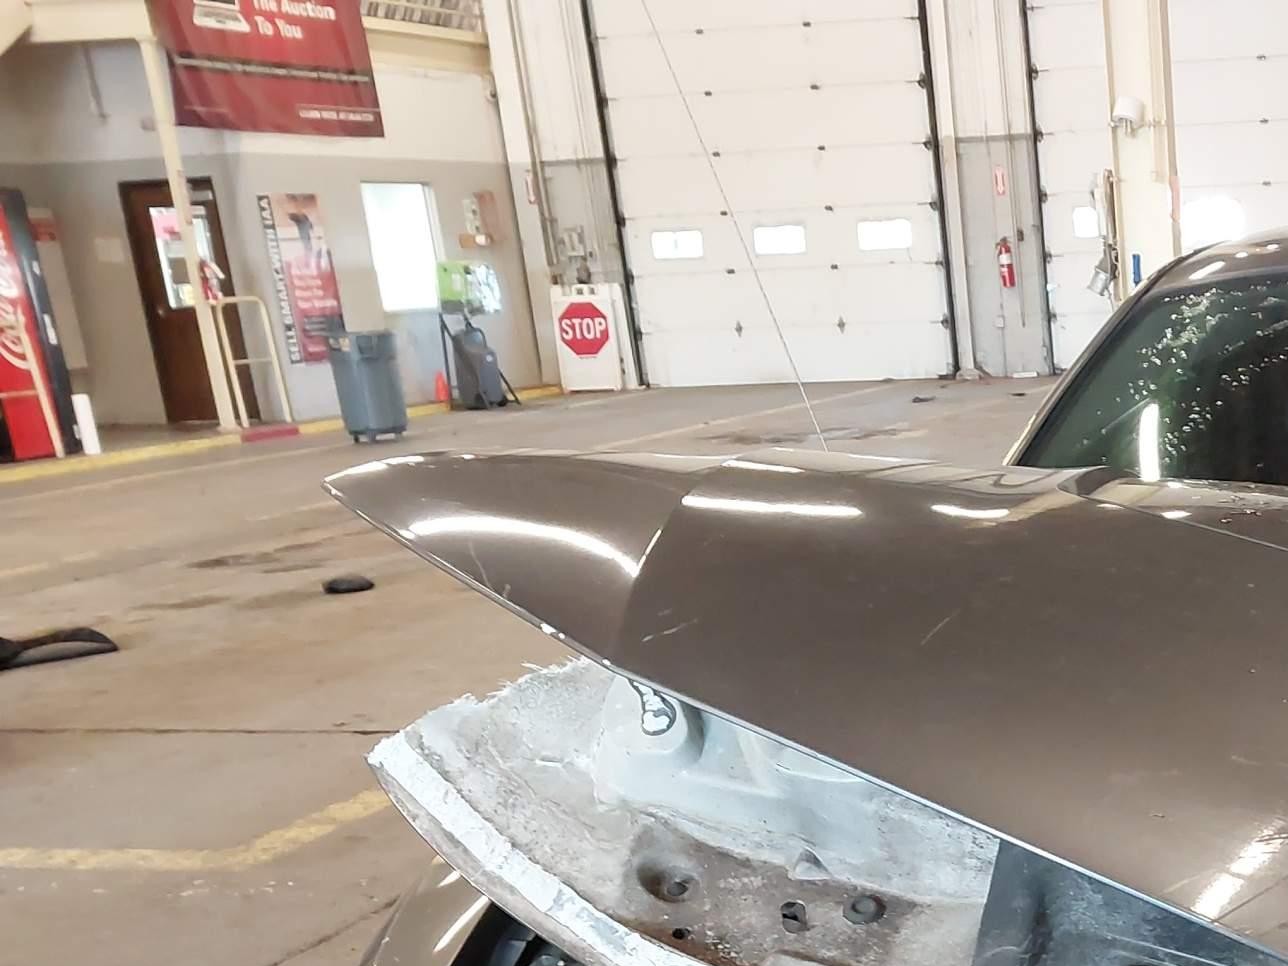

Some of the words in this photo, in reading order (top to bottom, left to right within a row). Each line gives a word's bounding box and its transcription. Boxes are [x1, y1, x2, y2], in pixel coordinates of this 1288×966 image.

[281, 0, 336, 20] Auction
[255, 15, 273, 36] To
[275, 18, 303, 39] You
[561, 317, 607, 341] STOP
